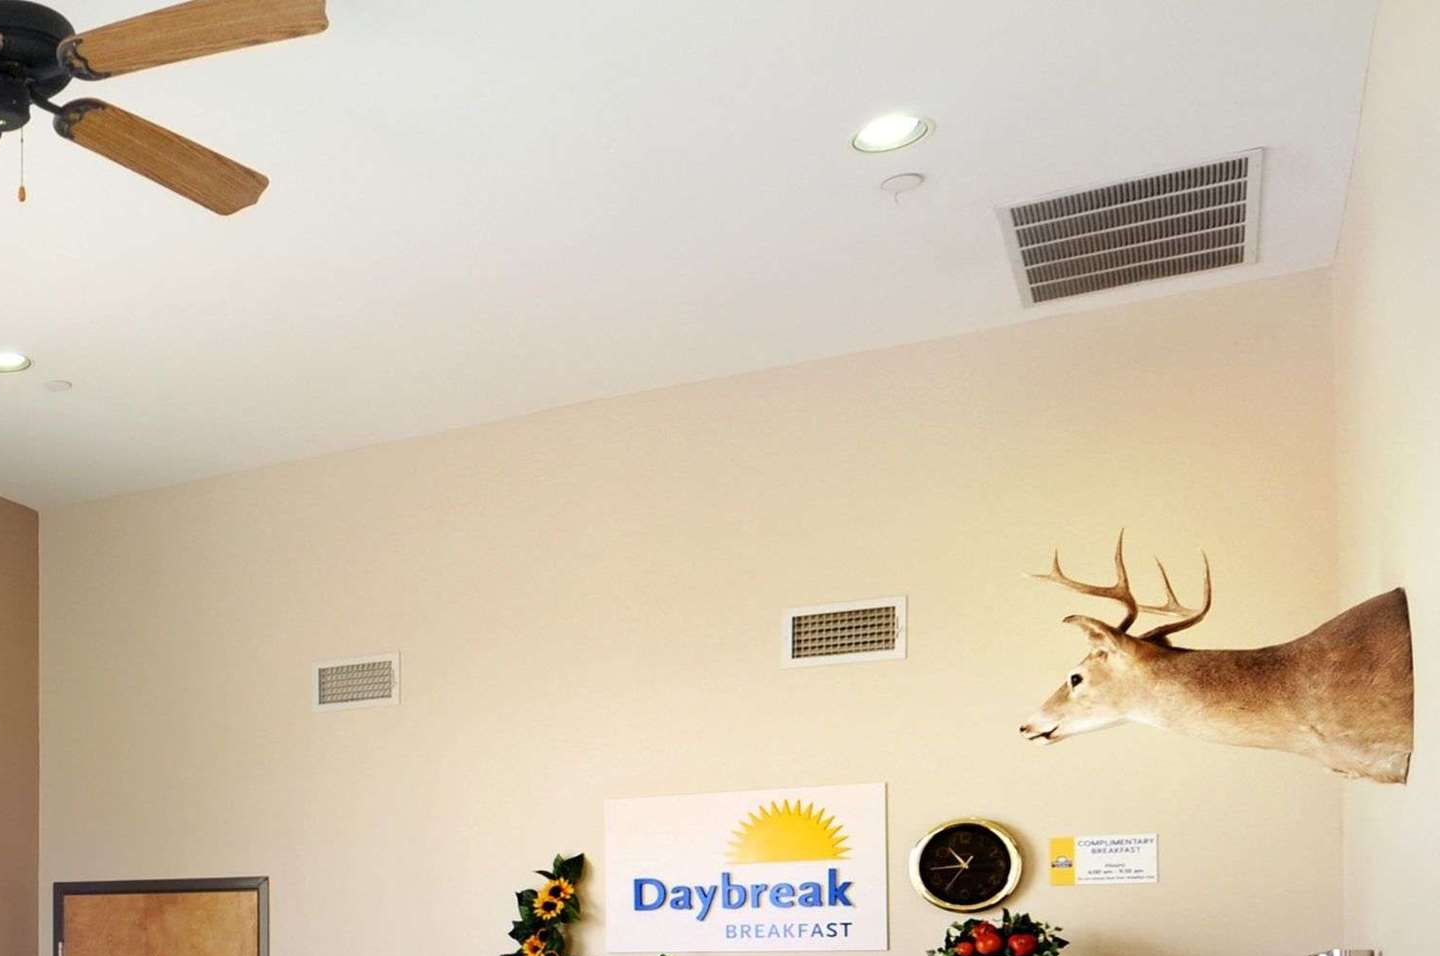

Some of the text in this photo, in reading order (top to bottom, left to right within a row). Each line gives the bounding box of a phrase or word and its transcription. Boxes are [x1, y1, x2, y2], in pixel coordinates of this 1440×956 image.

[1078, 838, 1154, 847] COMPLIMENTARY
[633, 868, 853, 922] Daybreak
[725, 922, 852, 939] BREAKFAST
